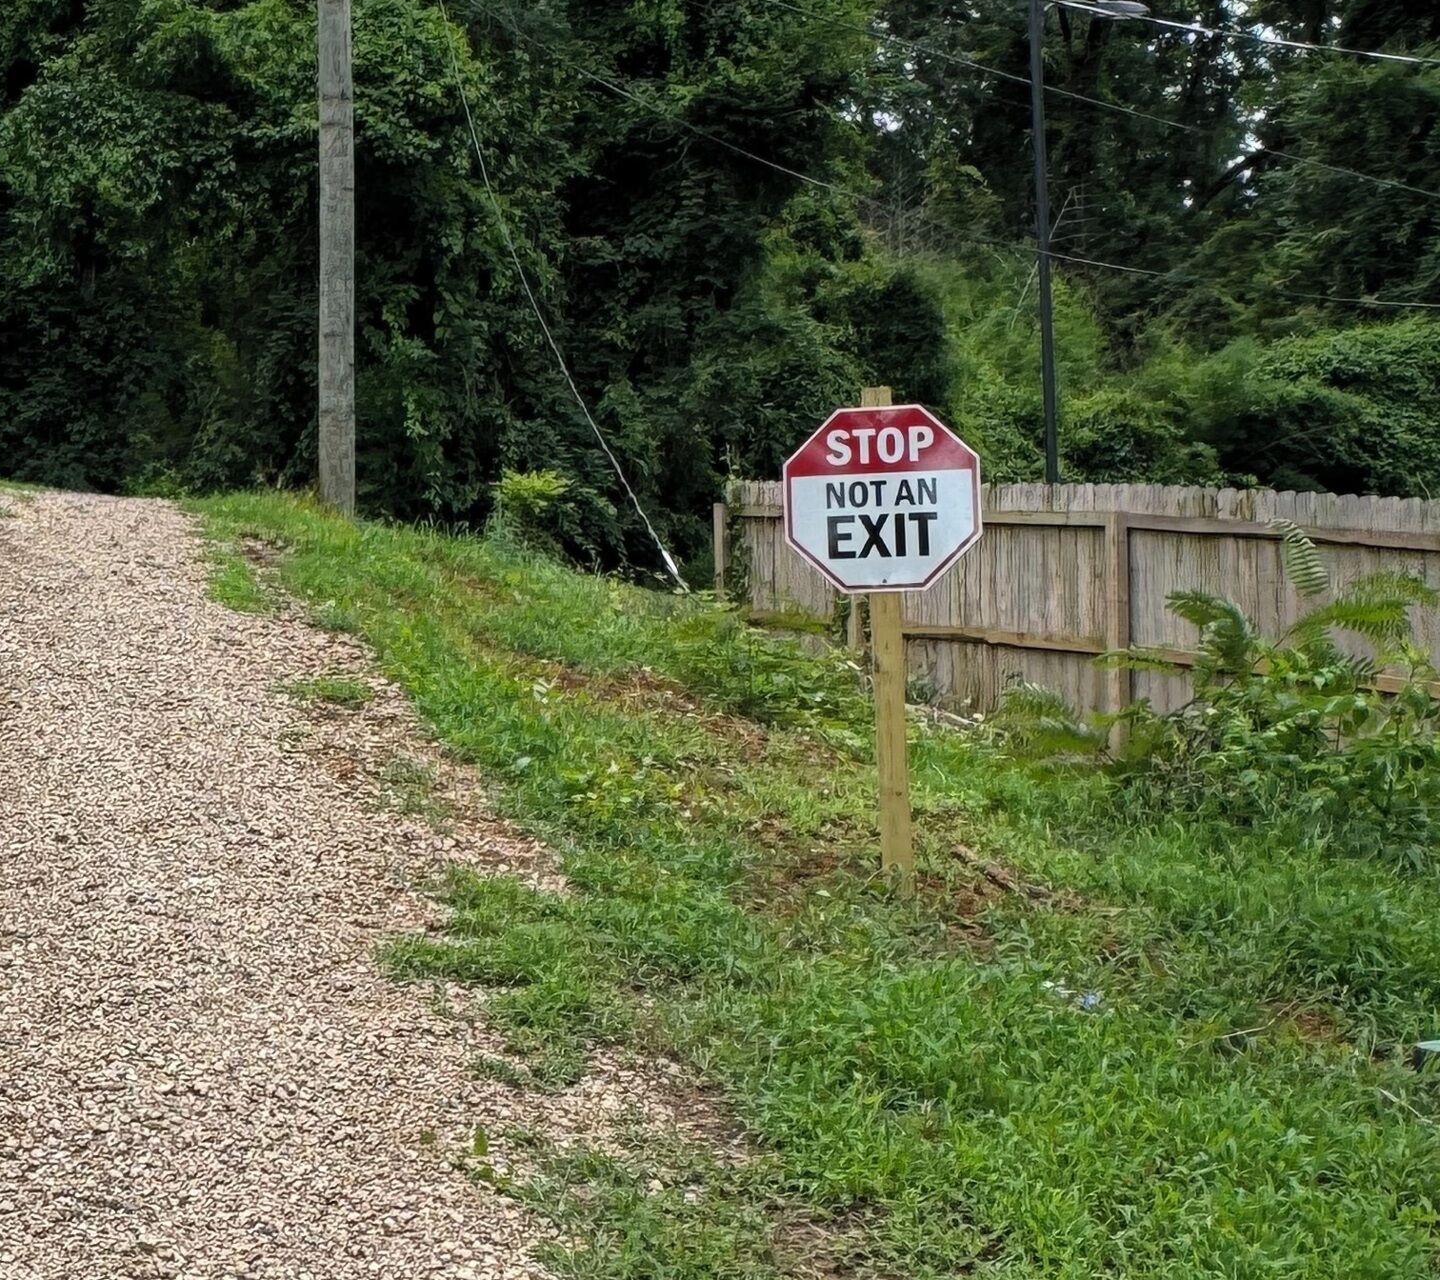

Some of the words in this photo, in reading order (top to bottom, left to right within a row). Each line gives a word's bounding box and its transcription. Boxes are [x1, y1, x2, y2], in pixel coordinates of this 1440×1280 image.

[826, 426, 934, 466] STOP
[826, 480, 887, 509] NOT
[894, 478, 938, 506] AN
[827, 513, 937, 559] EXIT
